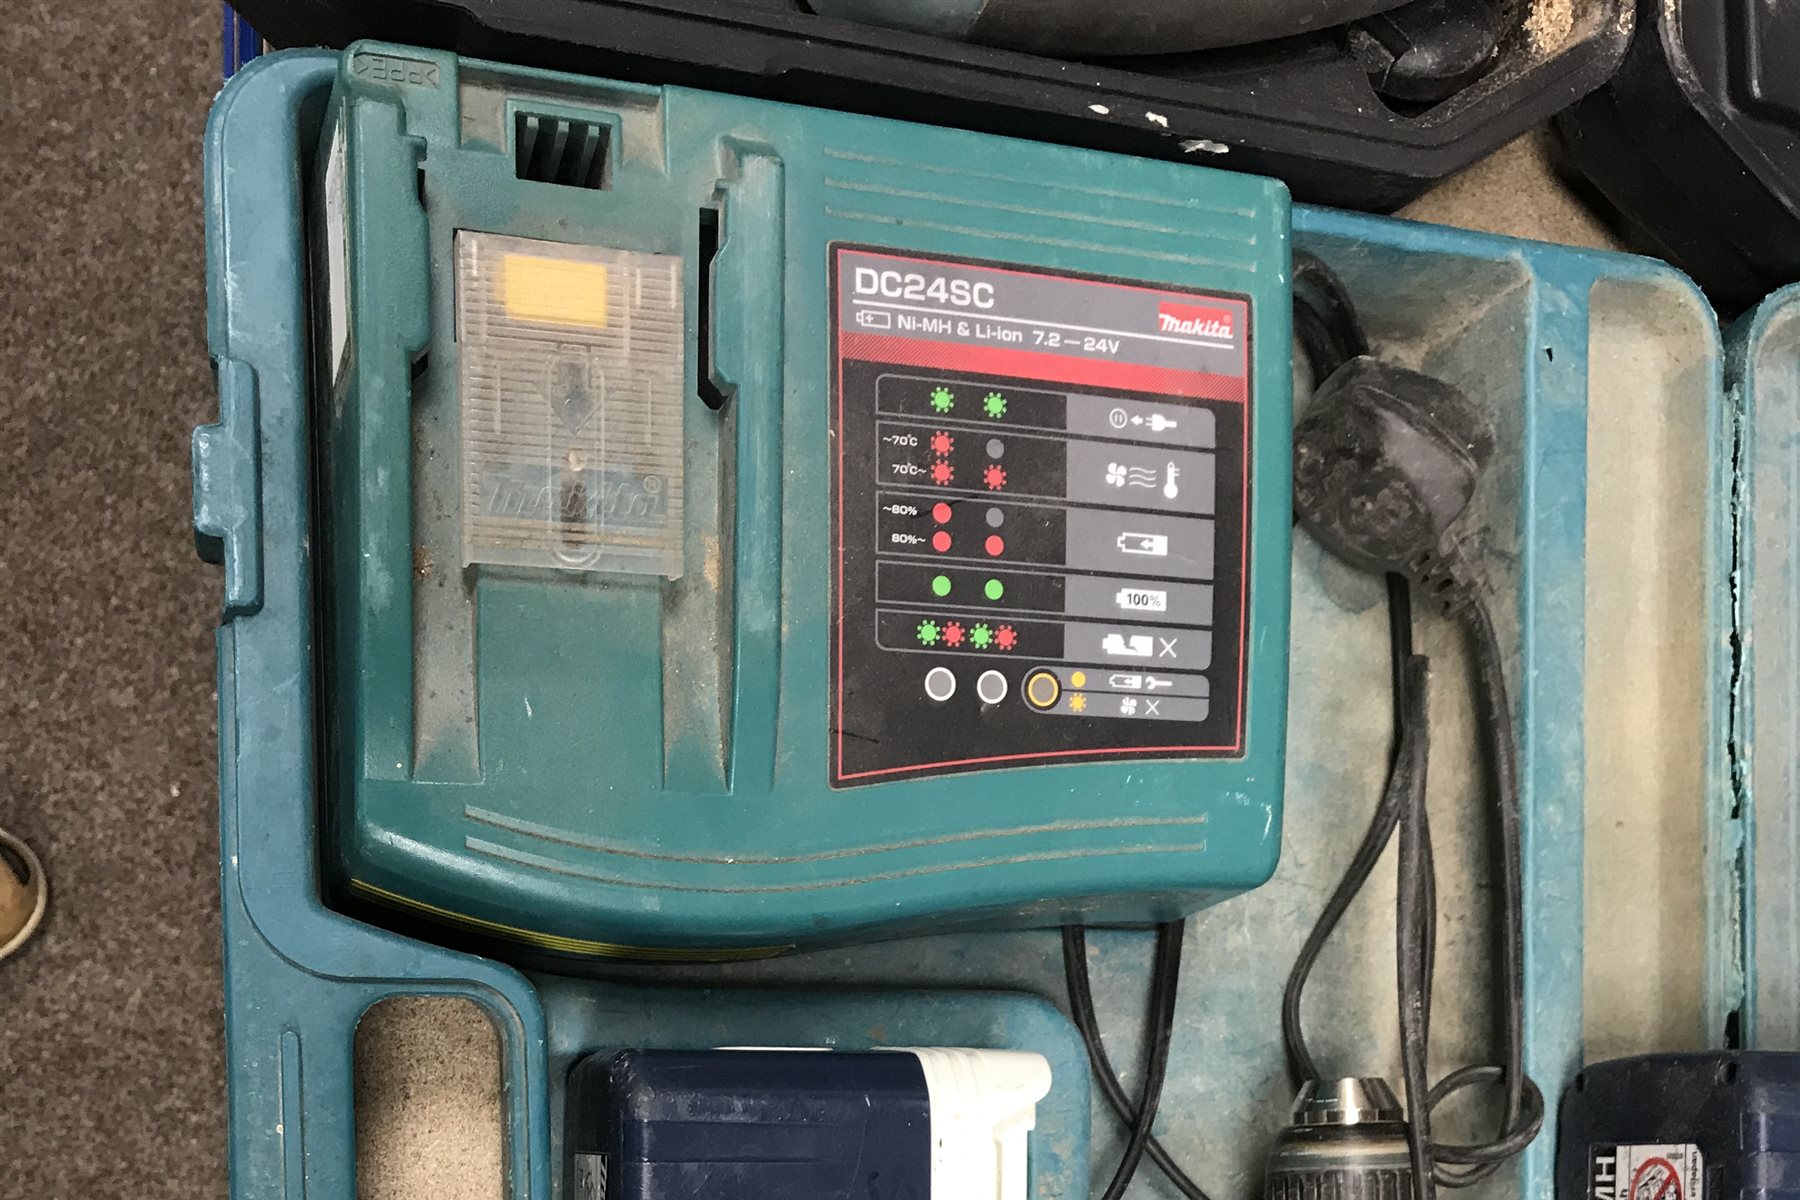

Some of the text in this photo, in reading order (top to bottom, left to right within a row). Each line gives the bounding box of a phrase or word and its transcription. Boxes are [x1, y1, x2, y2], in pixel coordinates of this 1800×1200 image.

[855, 267, 994, 308] DC24SC
[898, 314, 951, 335] Ni-MH
[957, 321, 970, 336] &
[976, 323, 1023, 342] Li-ion
[1127, 593, 1161, 606] 100%
